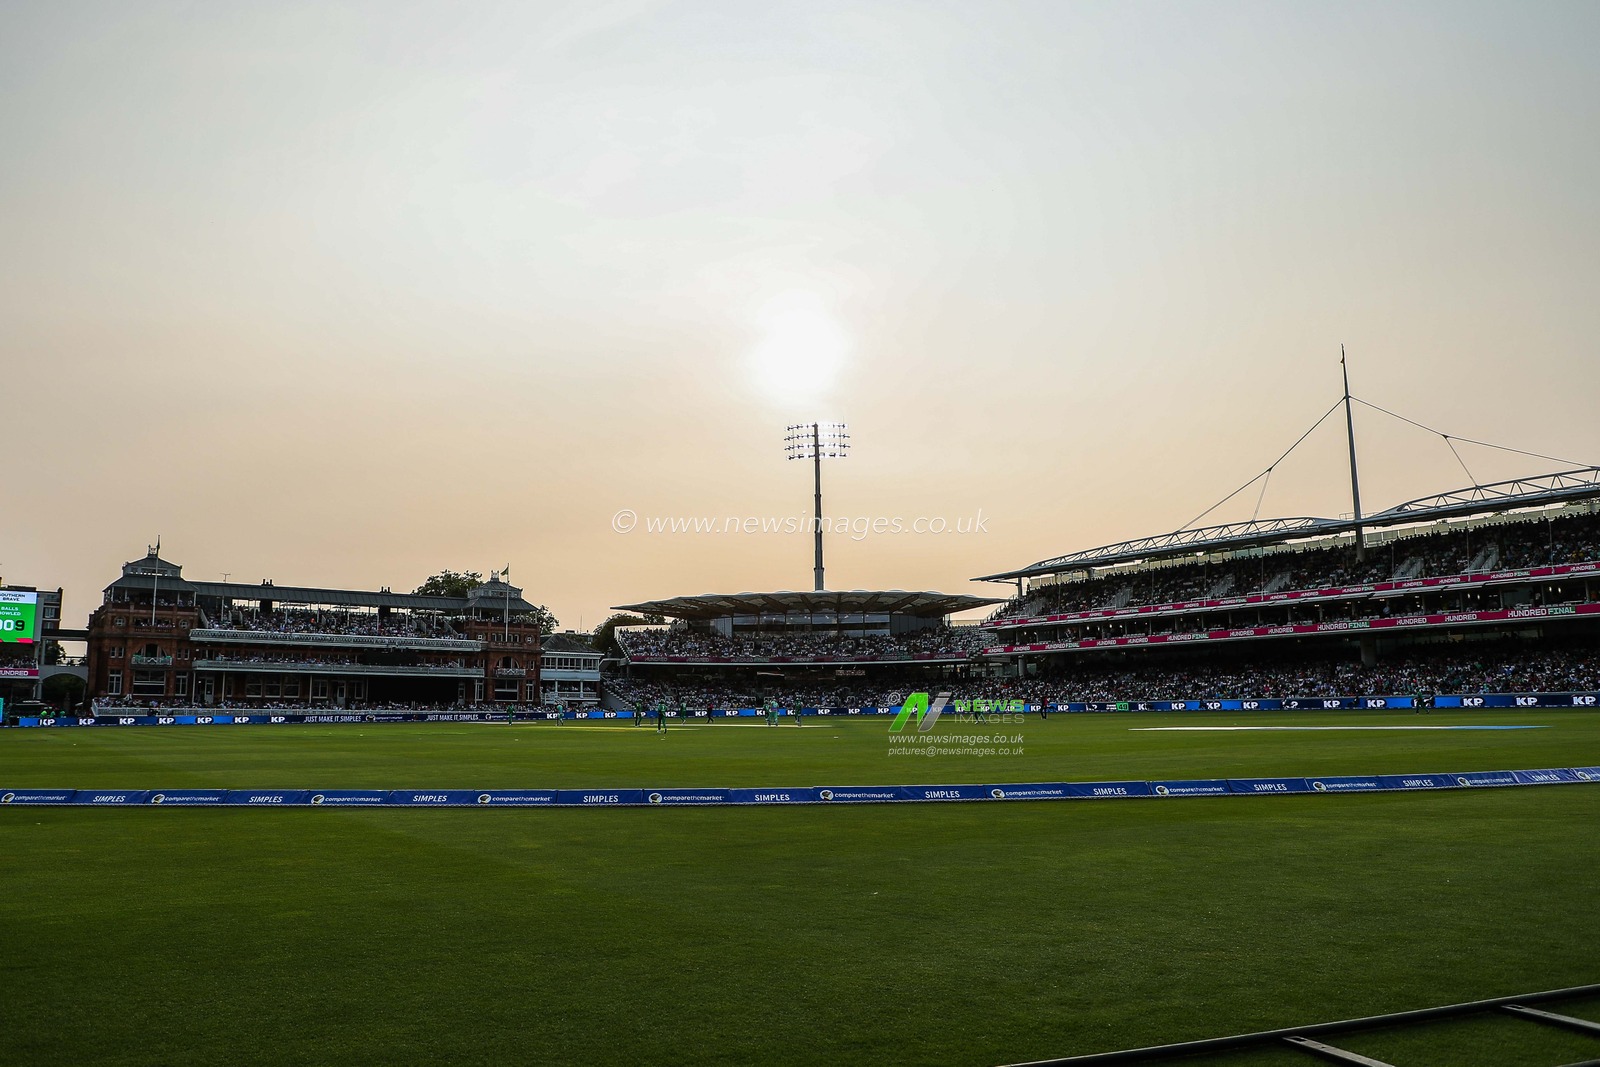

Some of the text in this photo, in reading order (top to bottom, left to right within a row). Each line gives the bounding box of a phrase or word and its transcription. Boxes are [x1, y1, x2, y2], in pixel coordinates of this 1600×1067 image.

[1508, 606, 1576, 618] HUNDRED FINAL
[1444, 614, 1478, 622] HUNDRED
[0, 619, 25, 632] 09
[1317, 623, 1348, 631] HUNDRED
[1324, 700, 1340, 708] KP
[1367, 700, 1386, 708] KP
[1463, 698, 1484, 706] KP
[1516, 696, 1538, 705] KP
[1572, 696, 1596, 704] KP
[925, 790, 960, 798] SIMPLES
